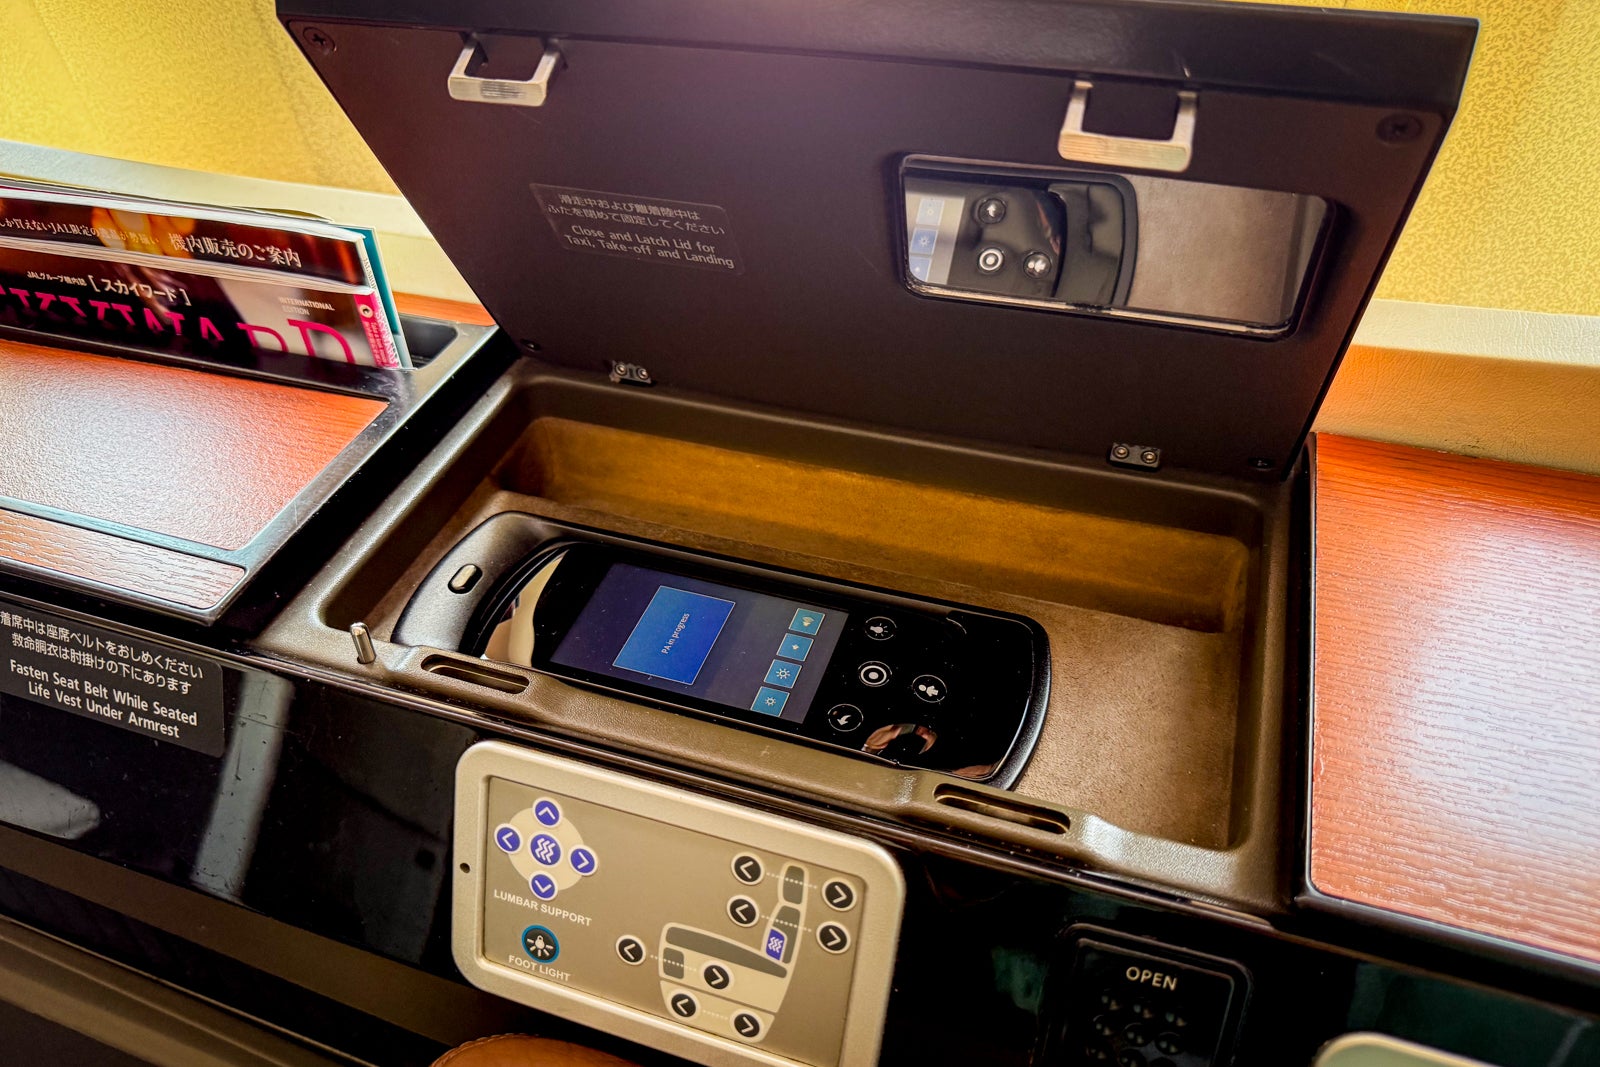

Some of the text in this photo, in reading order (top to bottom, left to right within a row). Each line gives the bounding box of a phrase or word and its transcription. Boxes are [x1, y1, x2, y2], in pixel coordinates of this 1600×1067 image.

[168, 231, 303, 268] 機内販売のご案内
[564, 234, 735, 269] Taxi, Take-off and Landing
[571, 225, 715, 254] Close and Latch Lid for
[279, 296, 335, 311] INTERNATIONAL
[282, 305, 311, 316] EDITION
[0, 611, 204, 679] 着席中は座席ベルトをおしめください
[661, 645, 672, 654] PA
[672, 613, 690, 639] progress
[11, 632, 192, 695] 救命胴衣は肘掛けの下にあります
[10, 659, 198, 726] Fasten Seat Belt While Seated
[28, 681, 180, 738] Life Vest Under Armrest
[493, 888, 592, 927] LUMBAR SUPPORT
[508, 954, 571, 982] FOOT LIGHT
[1125, 966, 1178, 991] OPEN
